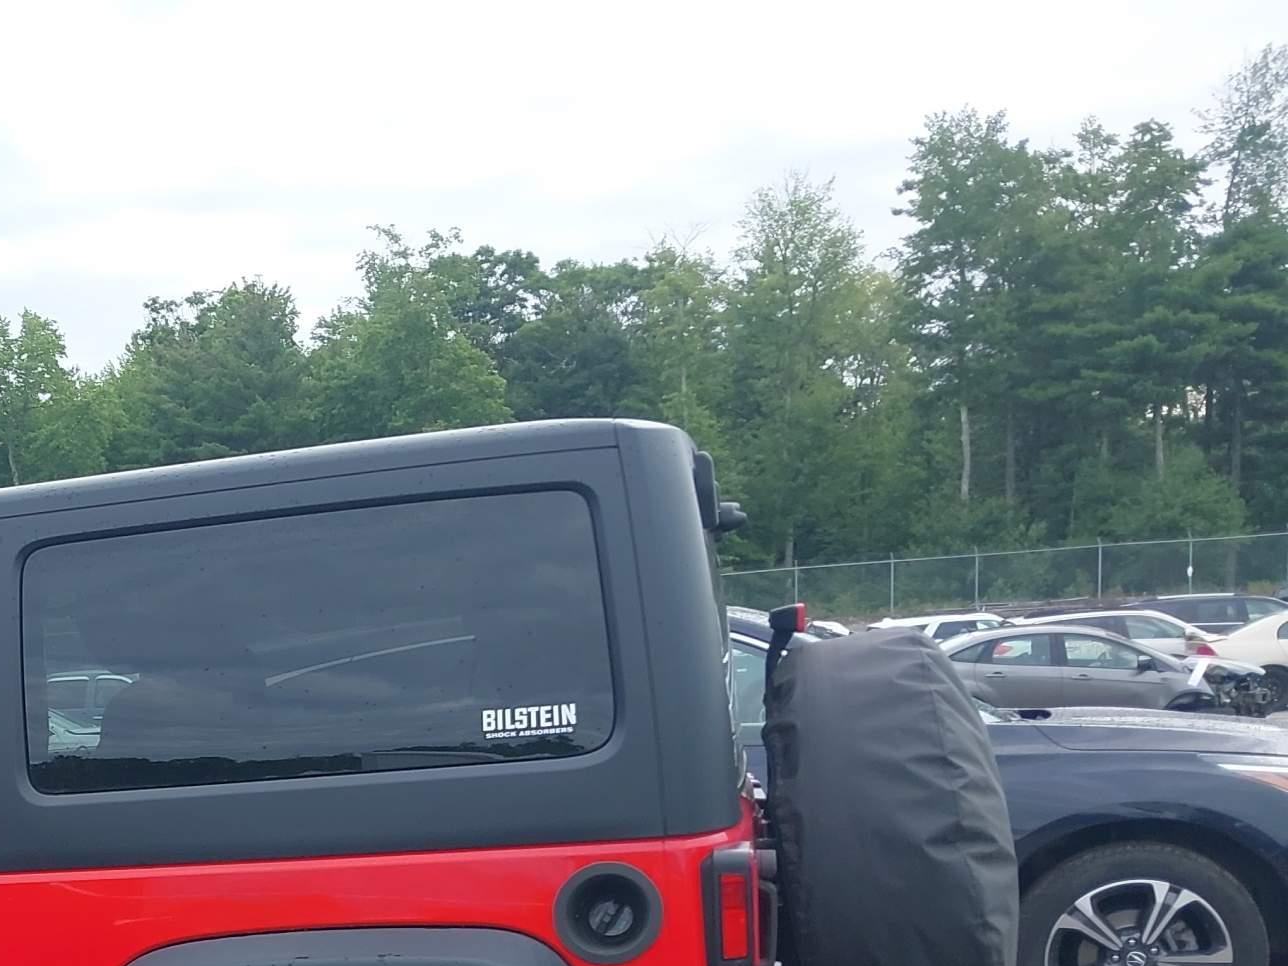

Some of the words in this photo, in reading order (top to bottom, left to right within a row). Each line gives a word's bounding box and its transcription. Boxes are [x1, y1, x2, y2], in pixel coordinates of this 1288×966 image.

[482, 703, 577, 732] BILSTEIN
[485, 731, 517, 739] SHOCK
[518, 726, 574, 737] ABSORBERS
